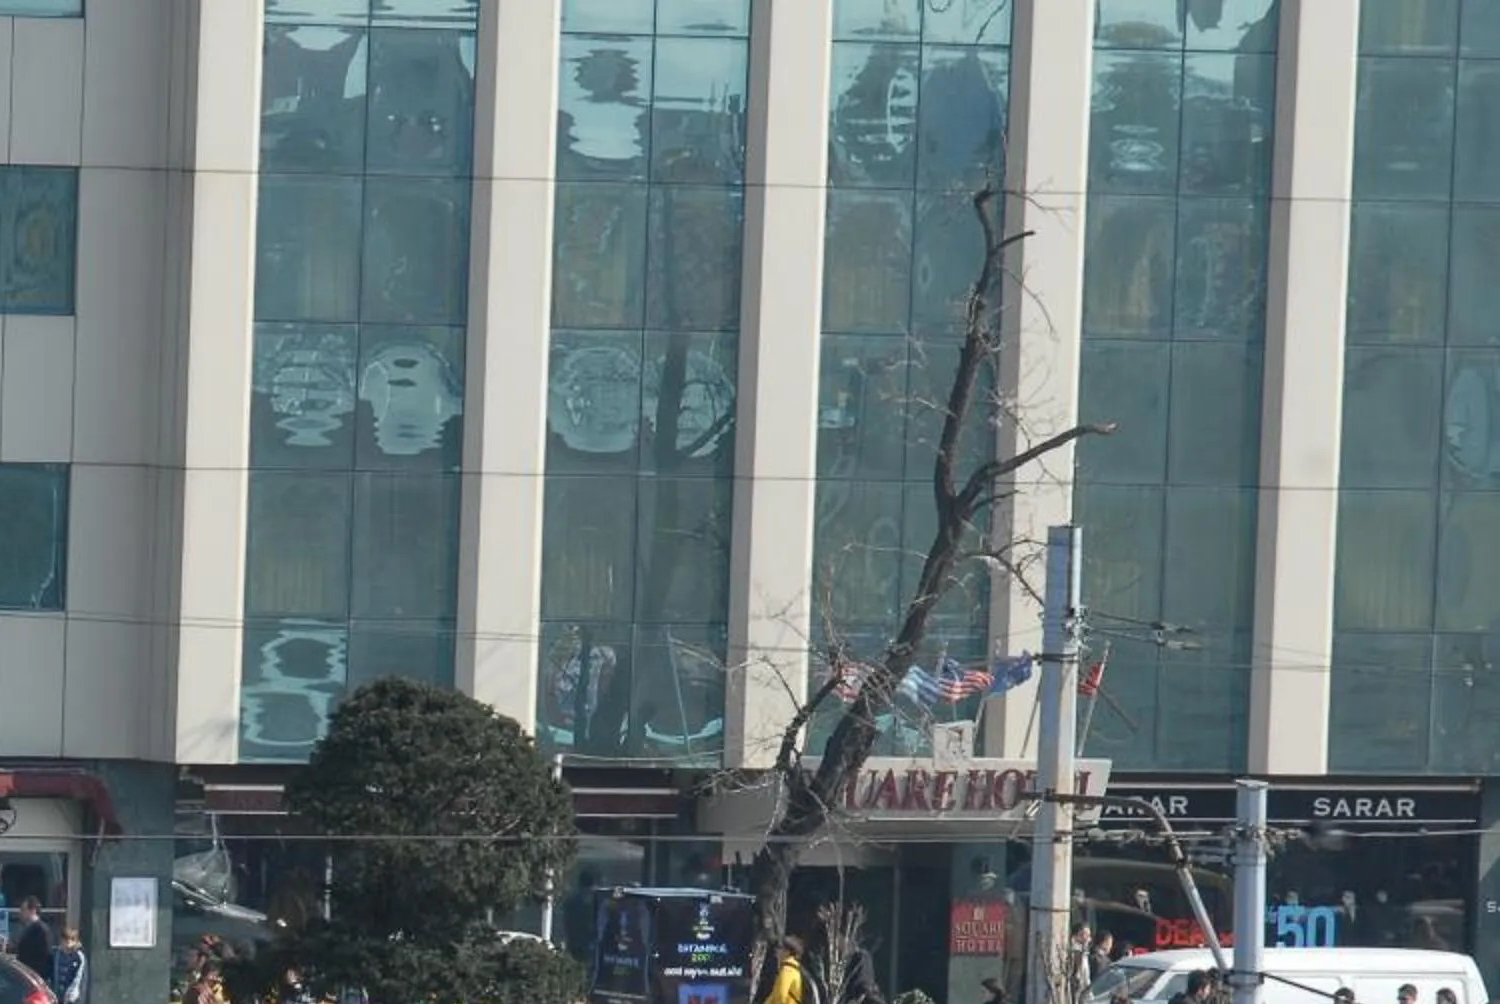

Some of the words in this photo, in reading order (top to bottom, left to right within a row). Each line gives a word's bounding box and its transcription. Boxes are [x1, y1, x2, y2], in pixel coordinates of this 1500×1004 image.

[844, 767, 959, 810] UARE
[963, 768, 1093, 811] HOL
[1313, 797, 1416, 817] SARAR
